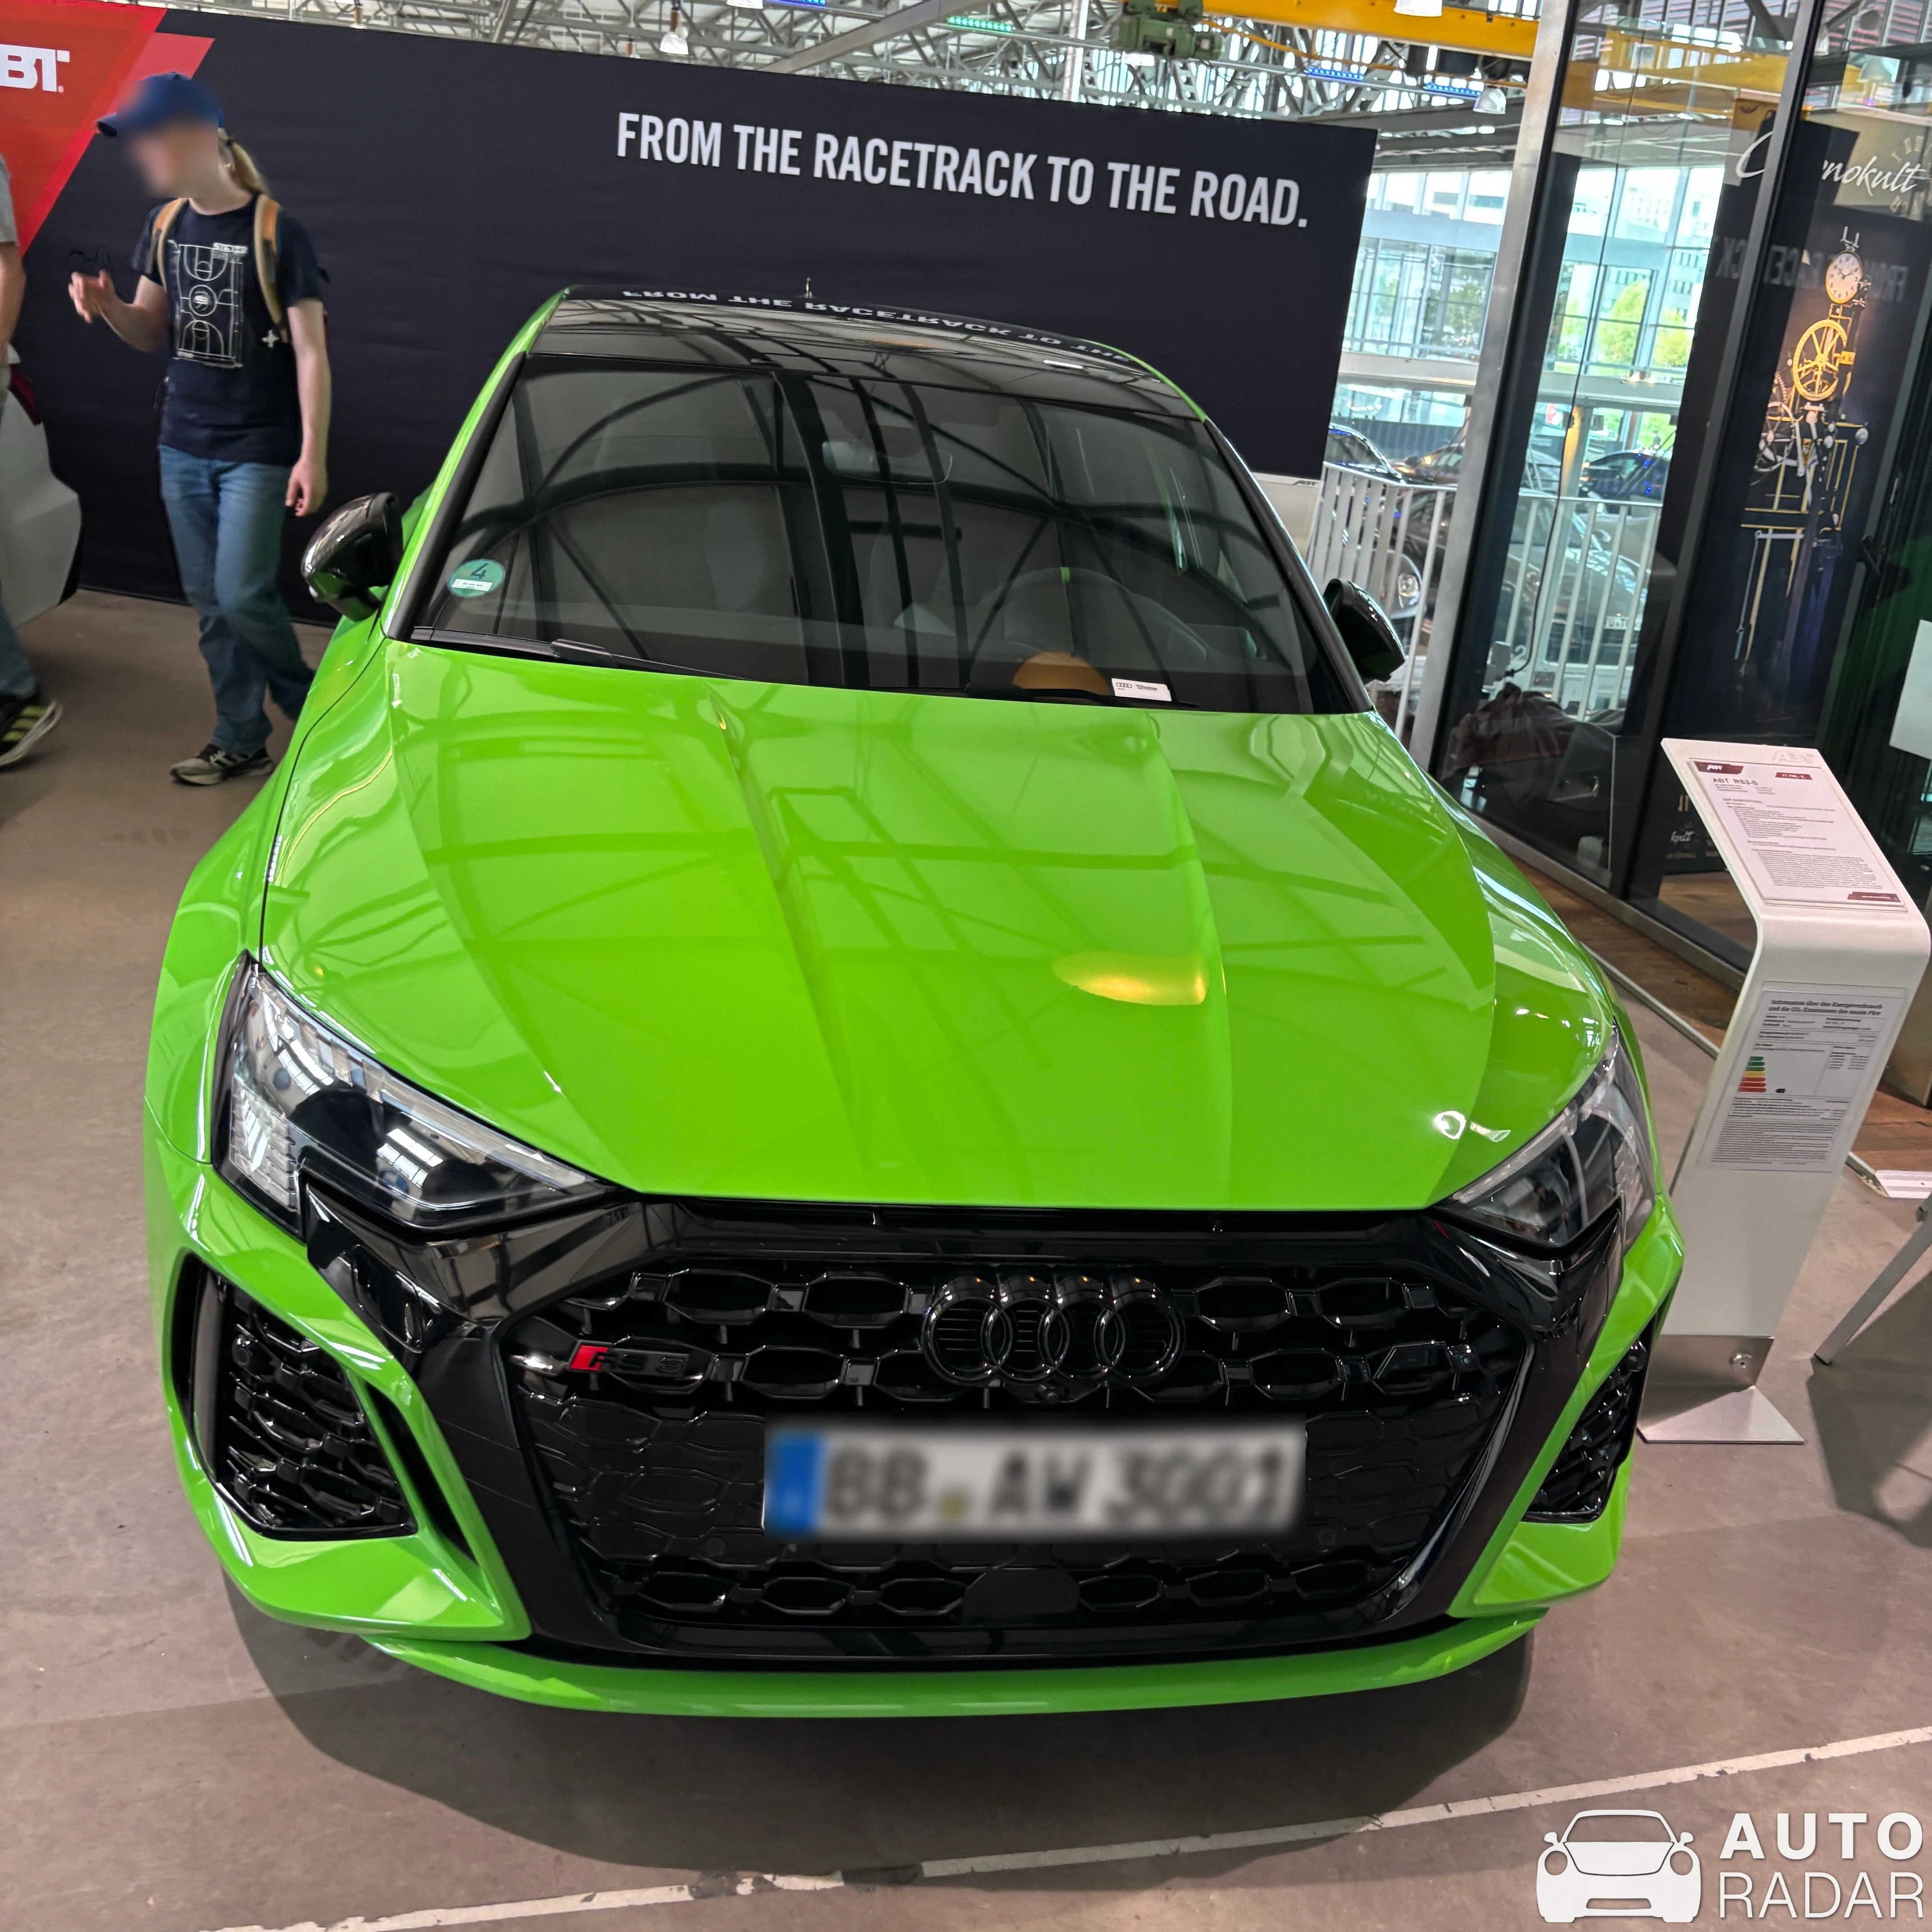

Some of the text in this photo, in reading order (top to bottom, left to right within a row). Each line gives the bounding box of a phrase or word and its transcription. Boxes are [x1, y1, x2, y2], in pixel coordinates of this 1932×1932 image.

[617, 112, 1307, 228] FROM THE RACETRACK TO THE ROAD.
[470, 563, 489, 580] 4
